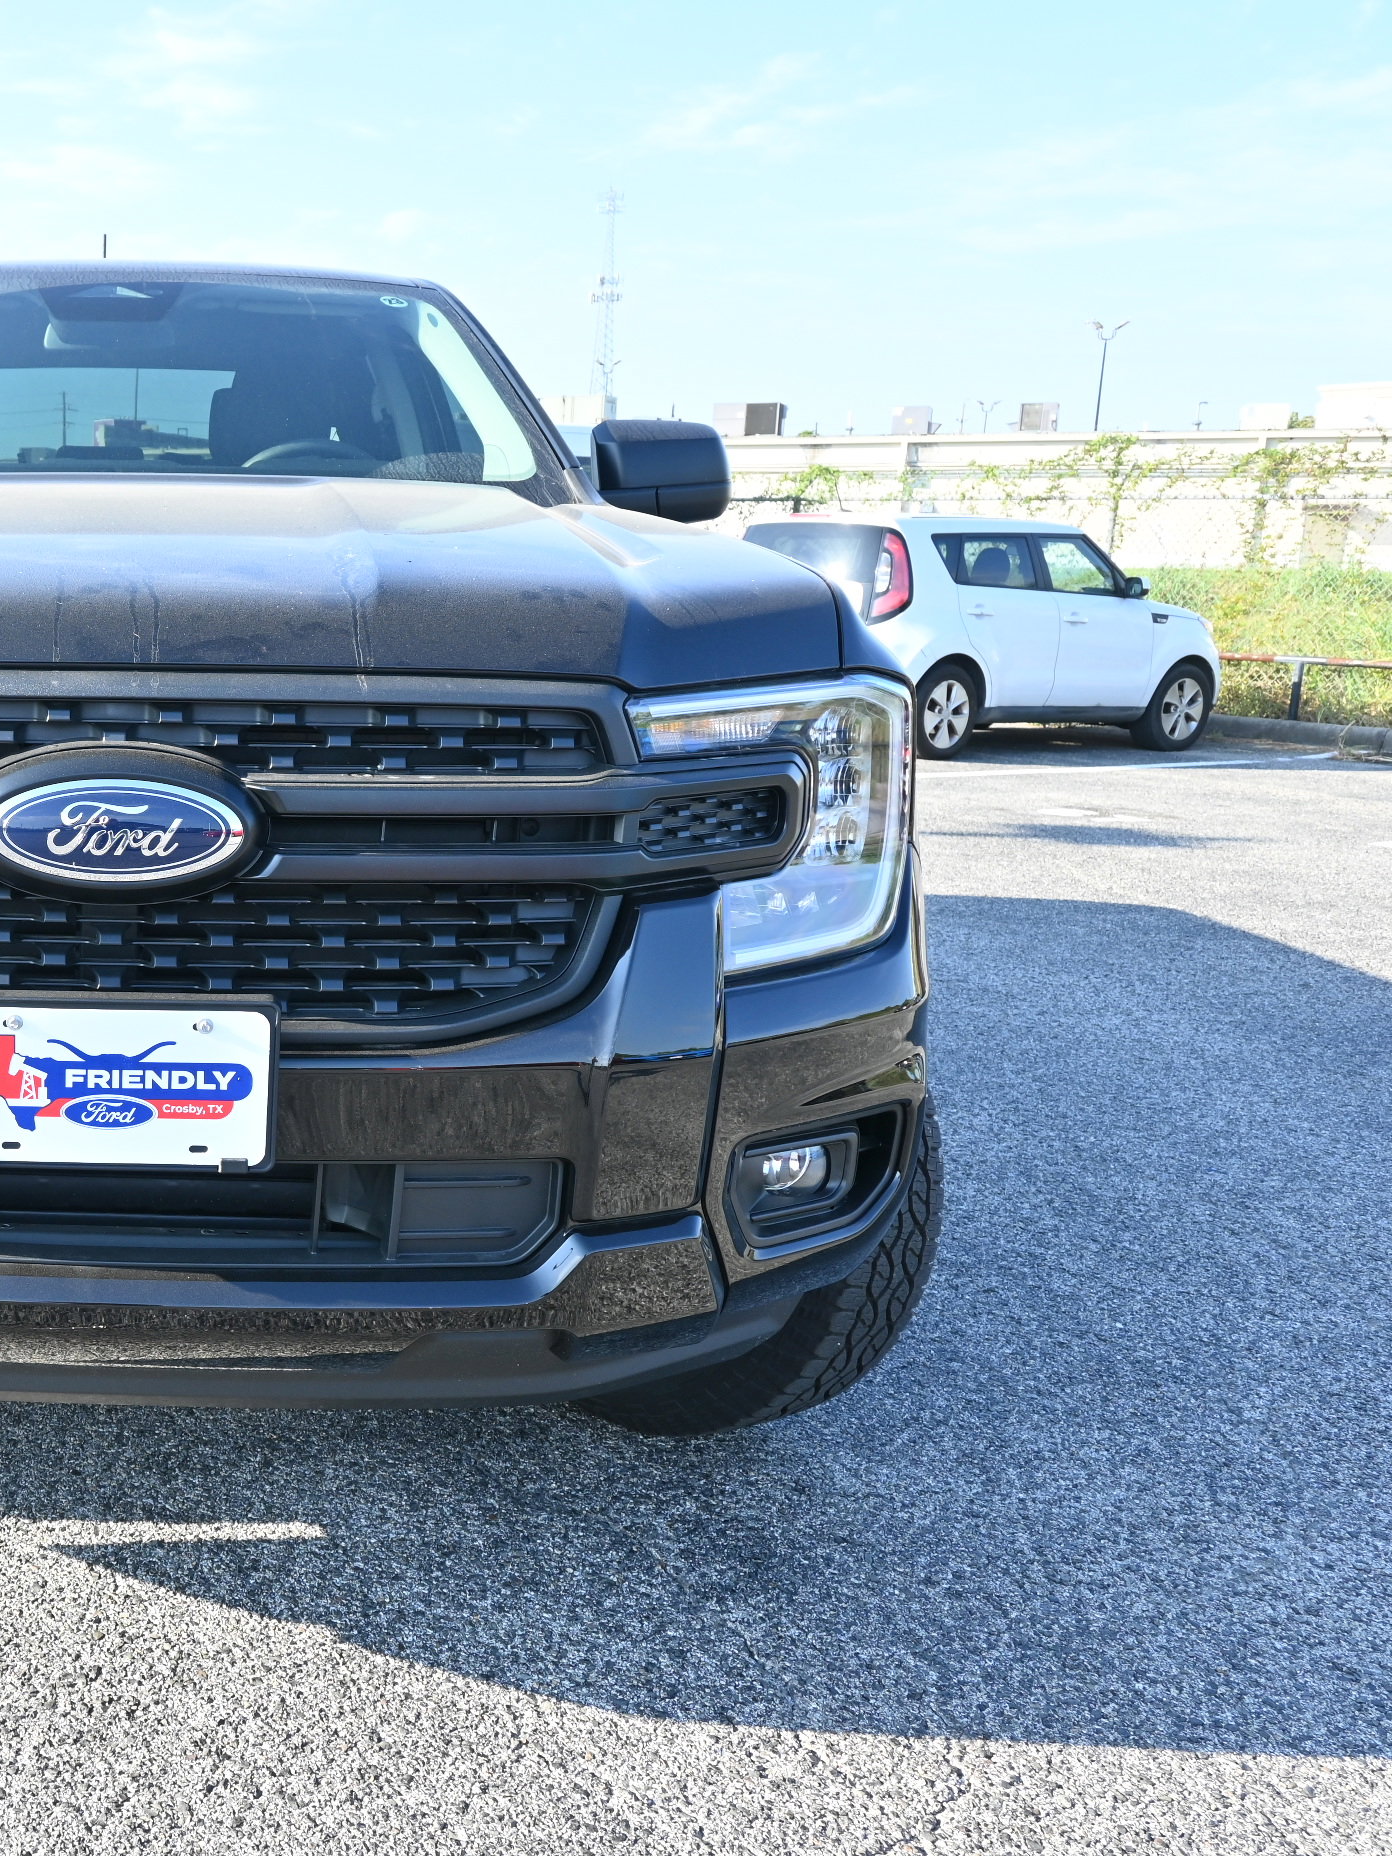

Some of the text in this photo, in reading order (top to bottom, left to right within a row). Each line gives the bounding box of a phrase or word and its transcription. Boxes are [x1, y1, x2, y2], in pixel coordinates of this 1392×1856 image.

[46, 801, 183, 857] Ford
[64, 1068, 239, 1091] FRIENDLY
[80, 1100, 136, 1124] Ford
[162, 1103, 224, 1116] Crosby, TX
